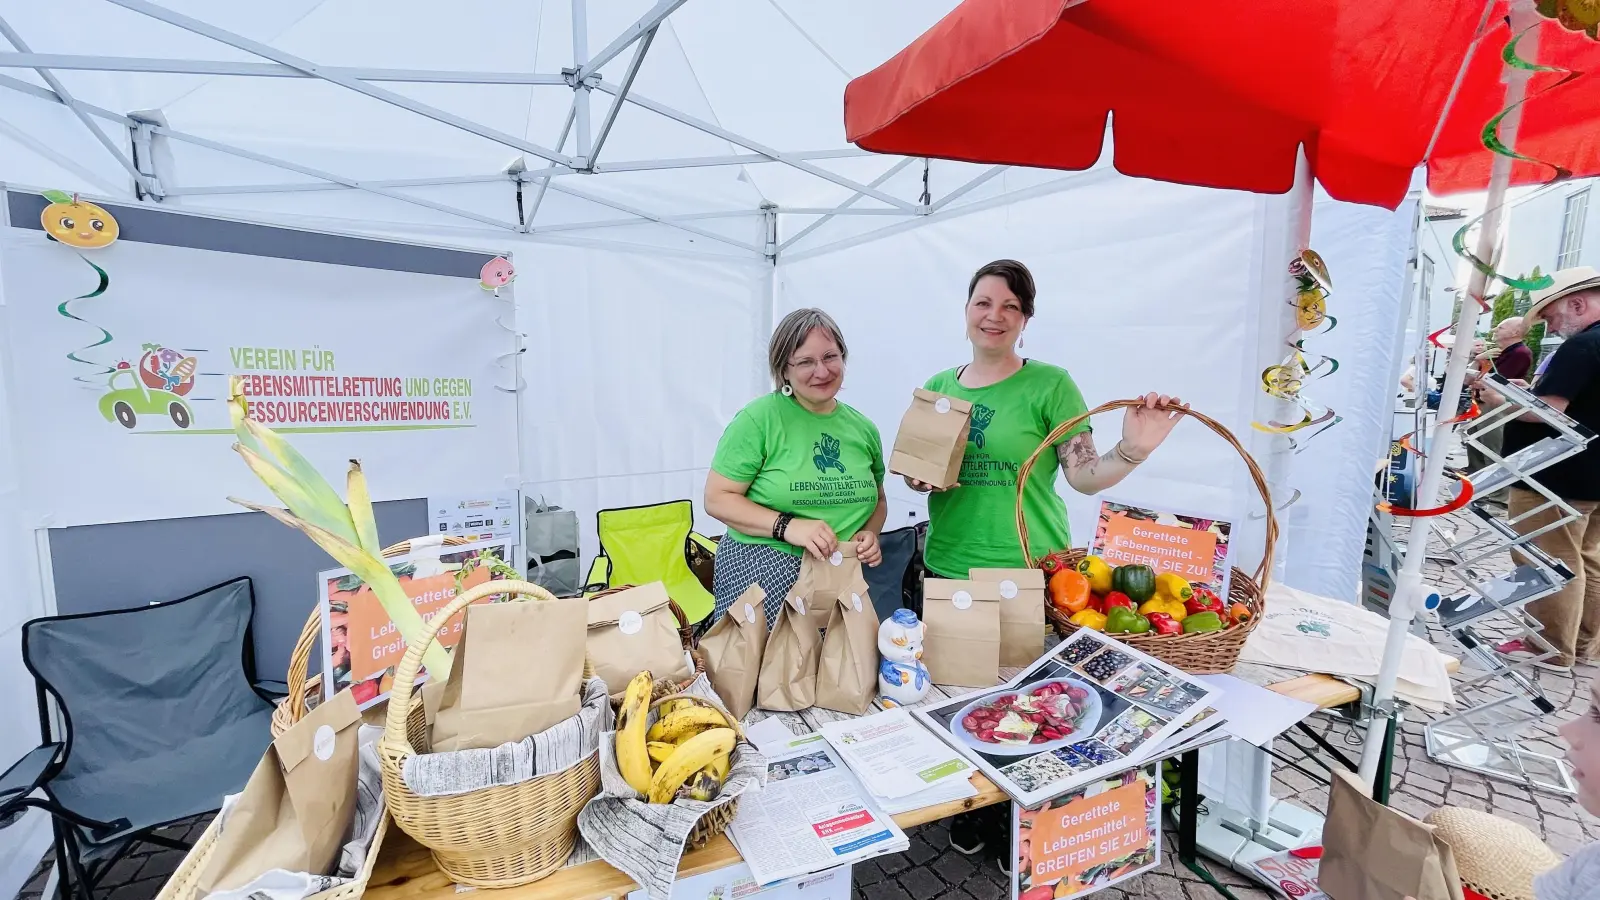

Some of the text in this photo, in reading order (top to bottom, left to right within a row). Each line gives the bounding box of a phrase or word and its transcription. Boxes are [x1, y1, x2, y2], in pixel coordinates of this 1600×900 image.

[230, 345, 335, 371] VEREIN FÜR
[242, 375, 472, 397] EBENSMITTELRETTUNG UND GEGEN
[247, 401, 472, 423] ESSOURCENVERSCHWENDUNG E.V.
[790, 480, 874, 491] LEBENSMITTELRETTUNG
[1114, 535, 1193, 560] Lebensmittel
[1132, 526, 1189, 545] Gerettete
[1106, 548, 1208, 577] GREIFEN SIE ZU!
[1061, 801, 1120, 828] Gerettete
[1043, 816, 1127, 855] Lebensmittel
[1036, 828, 1142, 875] GREIFEN SIE ZU!
